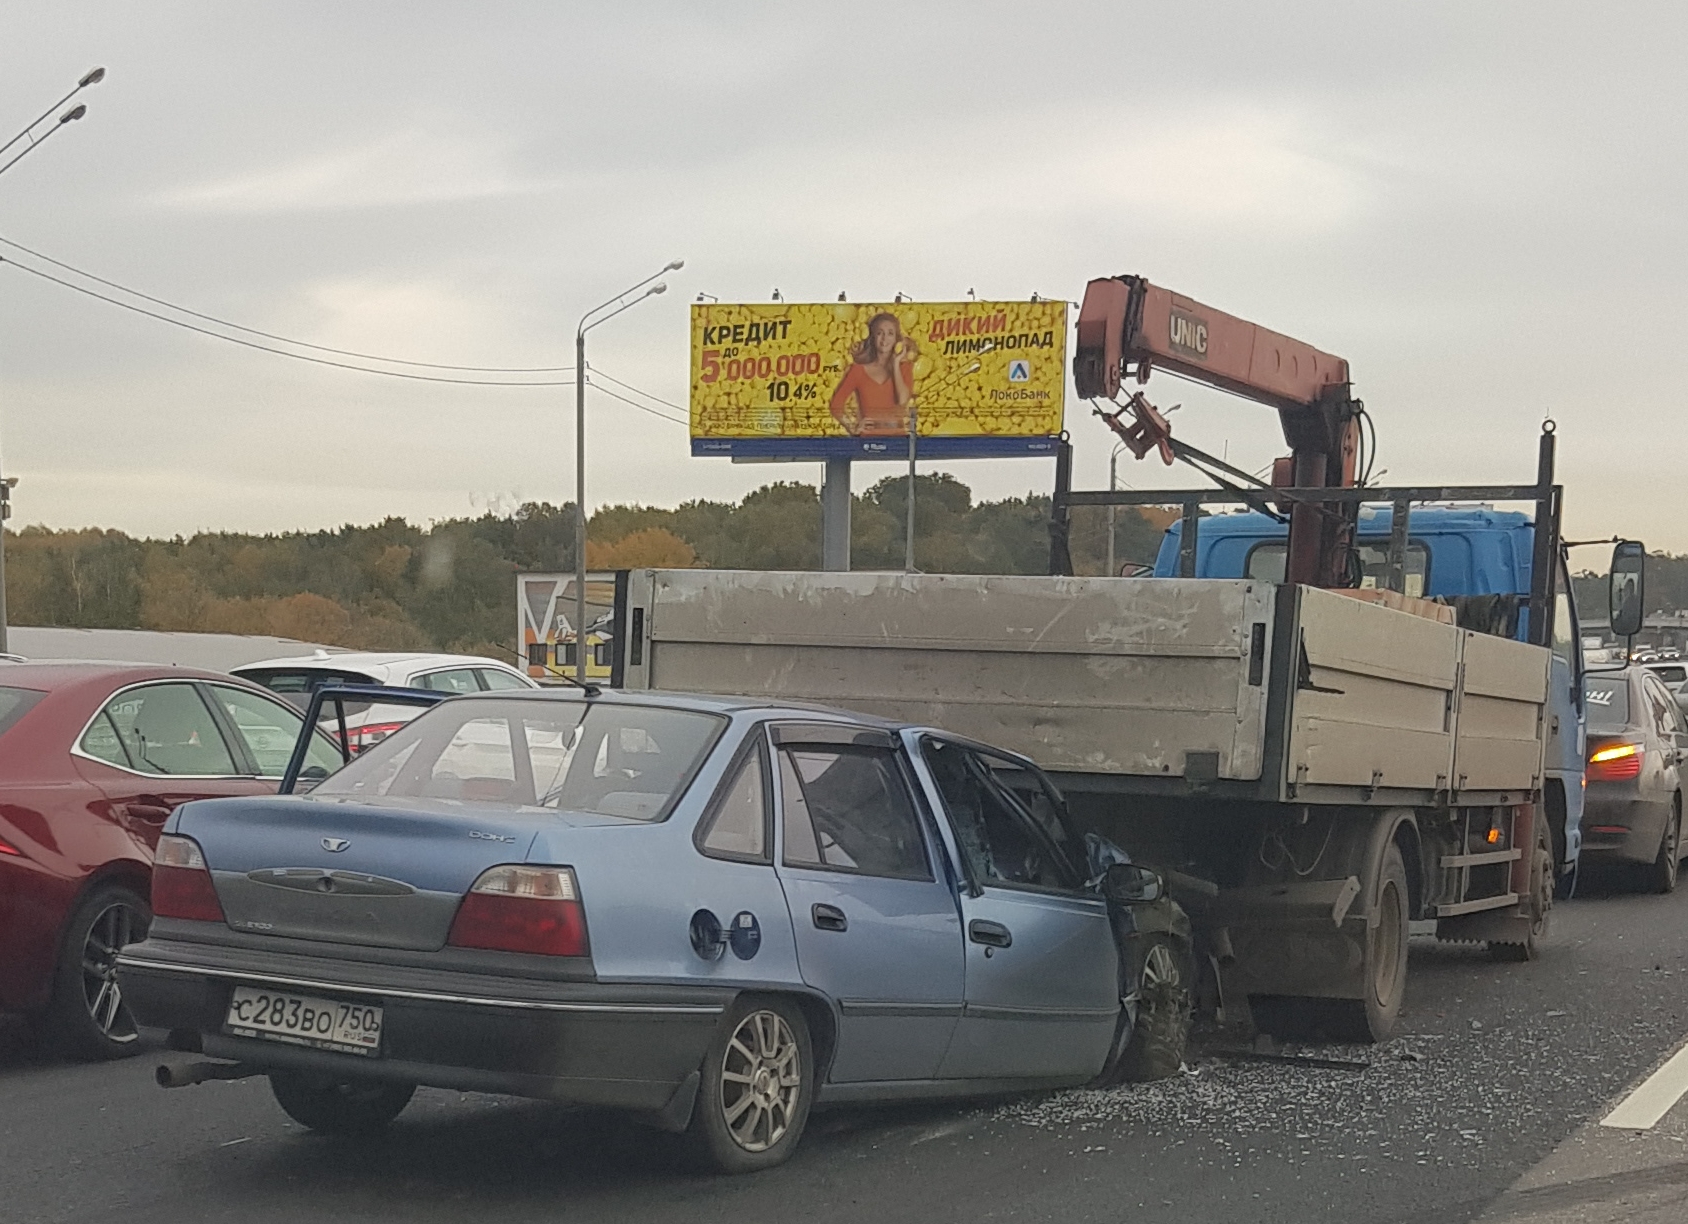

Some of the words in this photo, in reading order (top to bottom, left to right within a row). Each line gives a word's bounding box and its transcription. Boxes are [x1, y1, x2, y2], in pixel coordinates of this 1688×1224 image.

[702, 319, 792, 346] КРЕДИТ
[928, 308, 1006, 342] ДИКИЙ
[1170, 314, 1207, 353] UNIC
[943, 330, 1054, 355] ЛИМОНОПАД
[989, 388, 1050, 400] ЛокоБанк
[338, 1004, 375, 1032] 750
[343, 1030, 362, 1041] RUS
